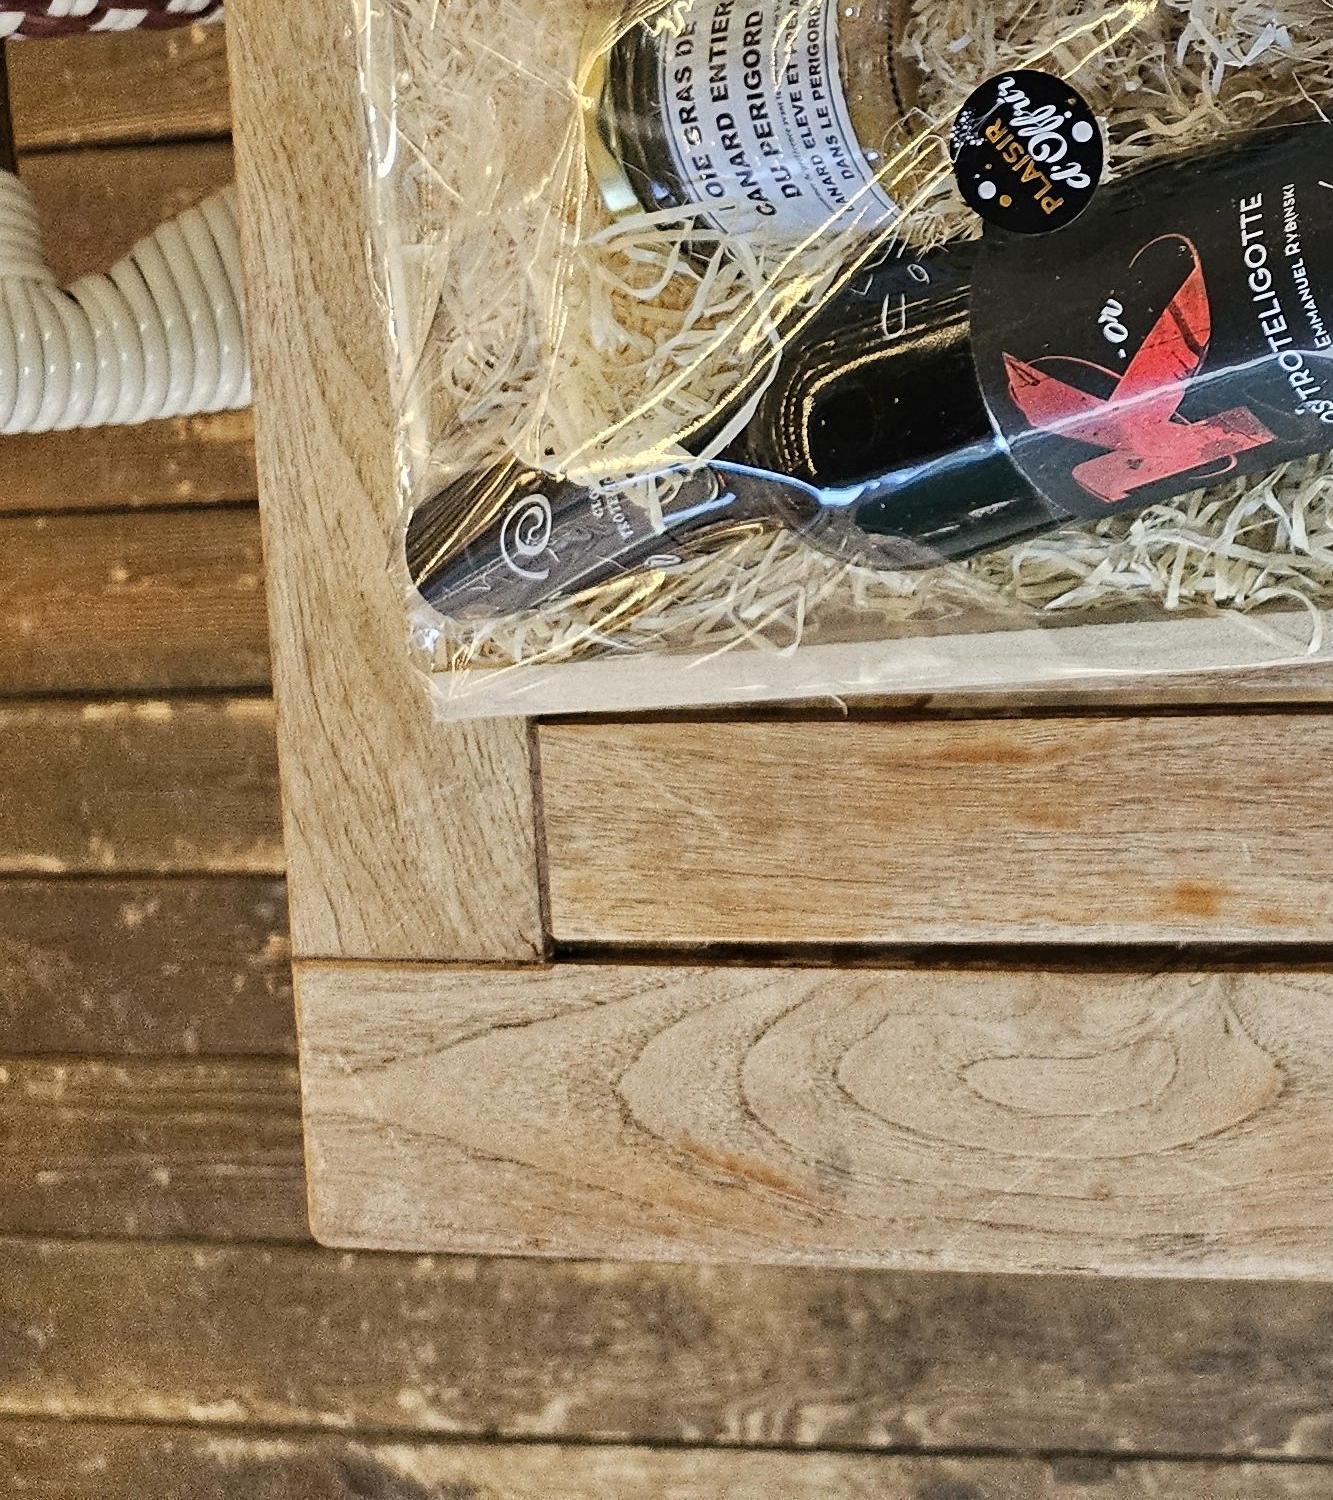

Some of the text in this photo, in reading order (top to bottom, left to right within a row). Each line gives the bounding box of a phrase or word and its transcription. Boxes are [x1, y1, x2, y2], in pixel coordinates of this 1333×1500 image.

[674, 20, 702, 146] GRAS DE
[708, 0, 778, 217] CANARD ENTIER
[742, 11, 783, 156] PERIGORD
[786, 62, 815, 149] ELEVE ET
[806, 4, 855, 181] DANS LE PERIGORD
[998, 76, 1091, 188] d'Offrir
[771, 165, 803, 198] DU
[985, 118, 1064, 214] PLAISIR
[1240, 192, 1322, 401] TROTELIGOTTE
[1290, 258, 1331, 348] EMMANUEL
